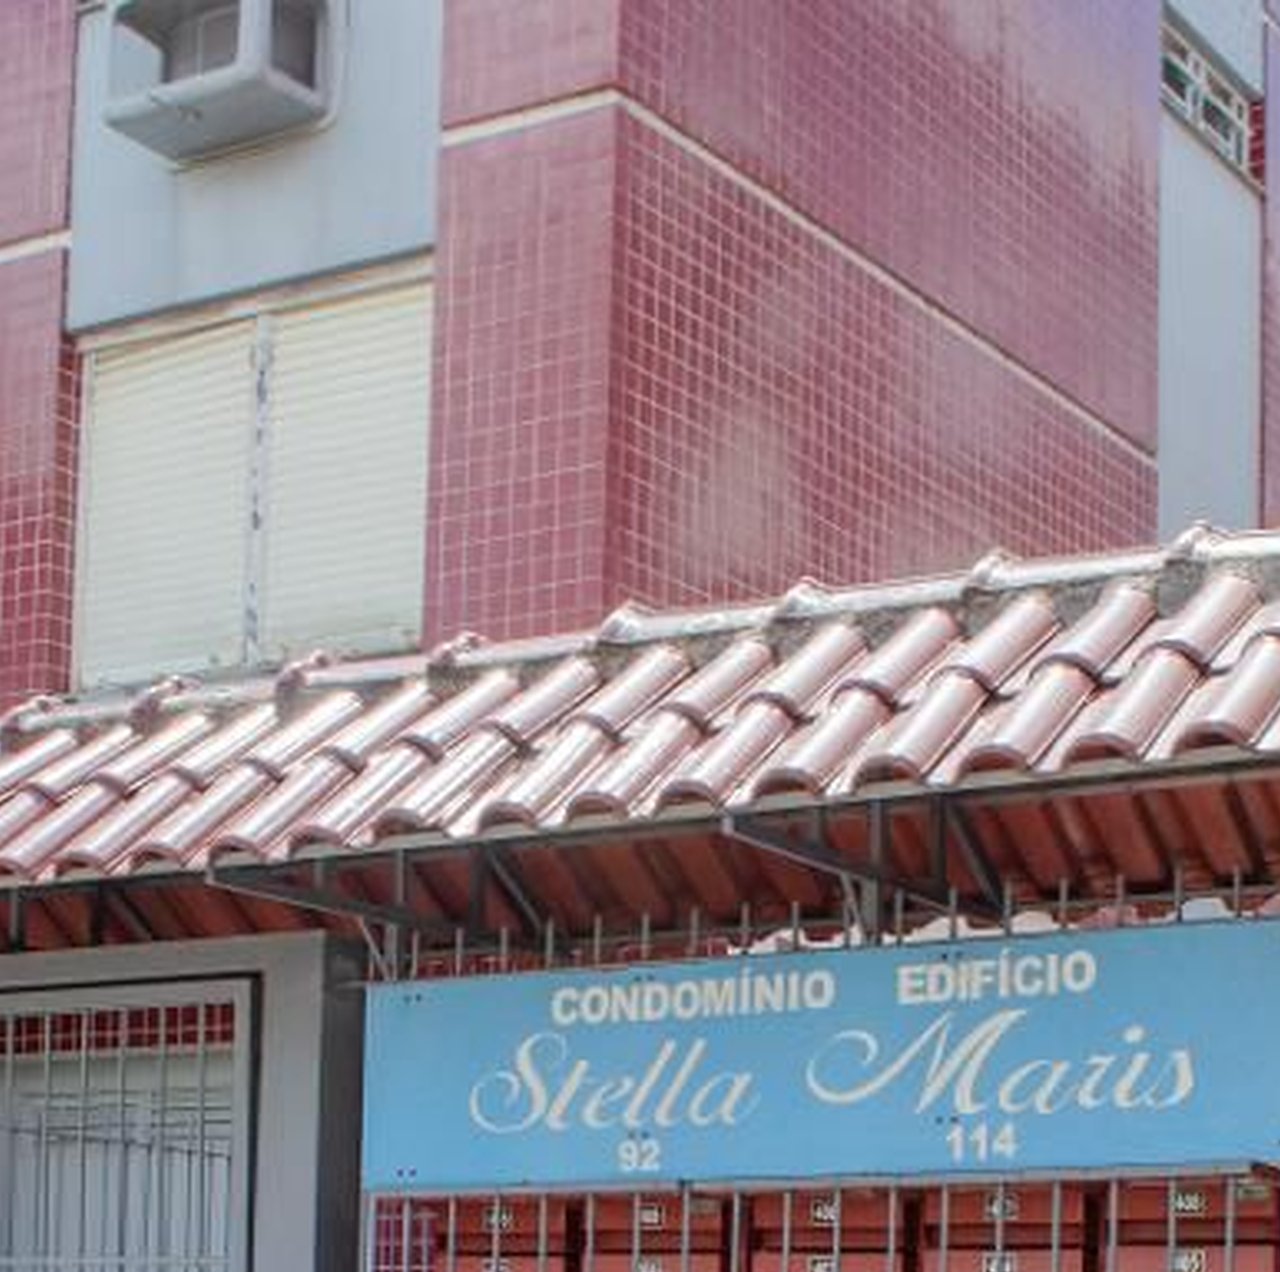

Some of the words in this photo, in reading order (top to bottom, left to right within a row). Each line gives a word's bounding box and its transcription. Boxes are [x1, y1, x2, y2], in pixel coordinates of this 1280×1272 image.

[551, 967, 835, 1026] CONDOMÍNIO
[897, 948, 1097, 1005] EDIFÍCIO
[469, 1031, 763, 1134] Stella
[805, 1007, 1195, 1115] Maris
[618, 1140, 661, 1173] 92
[946, 1120, 1019, 1163] 114
